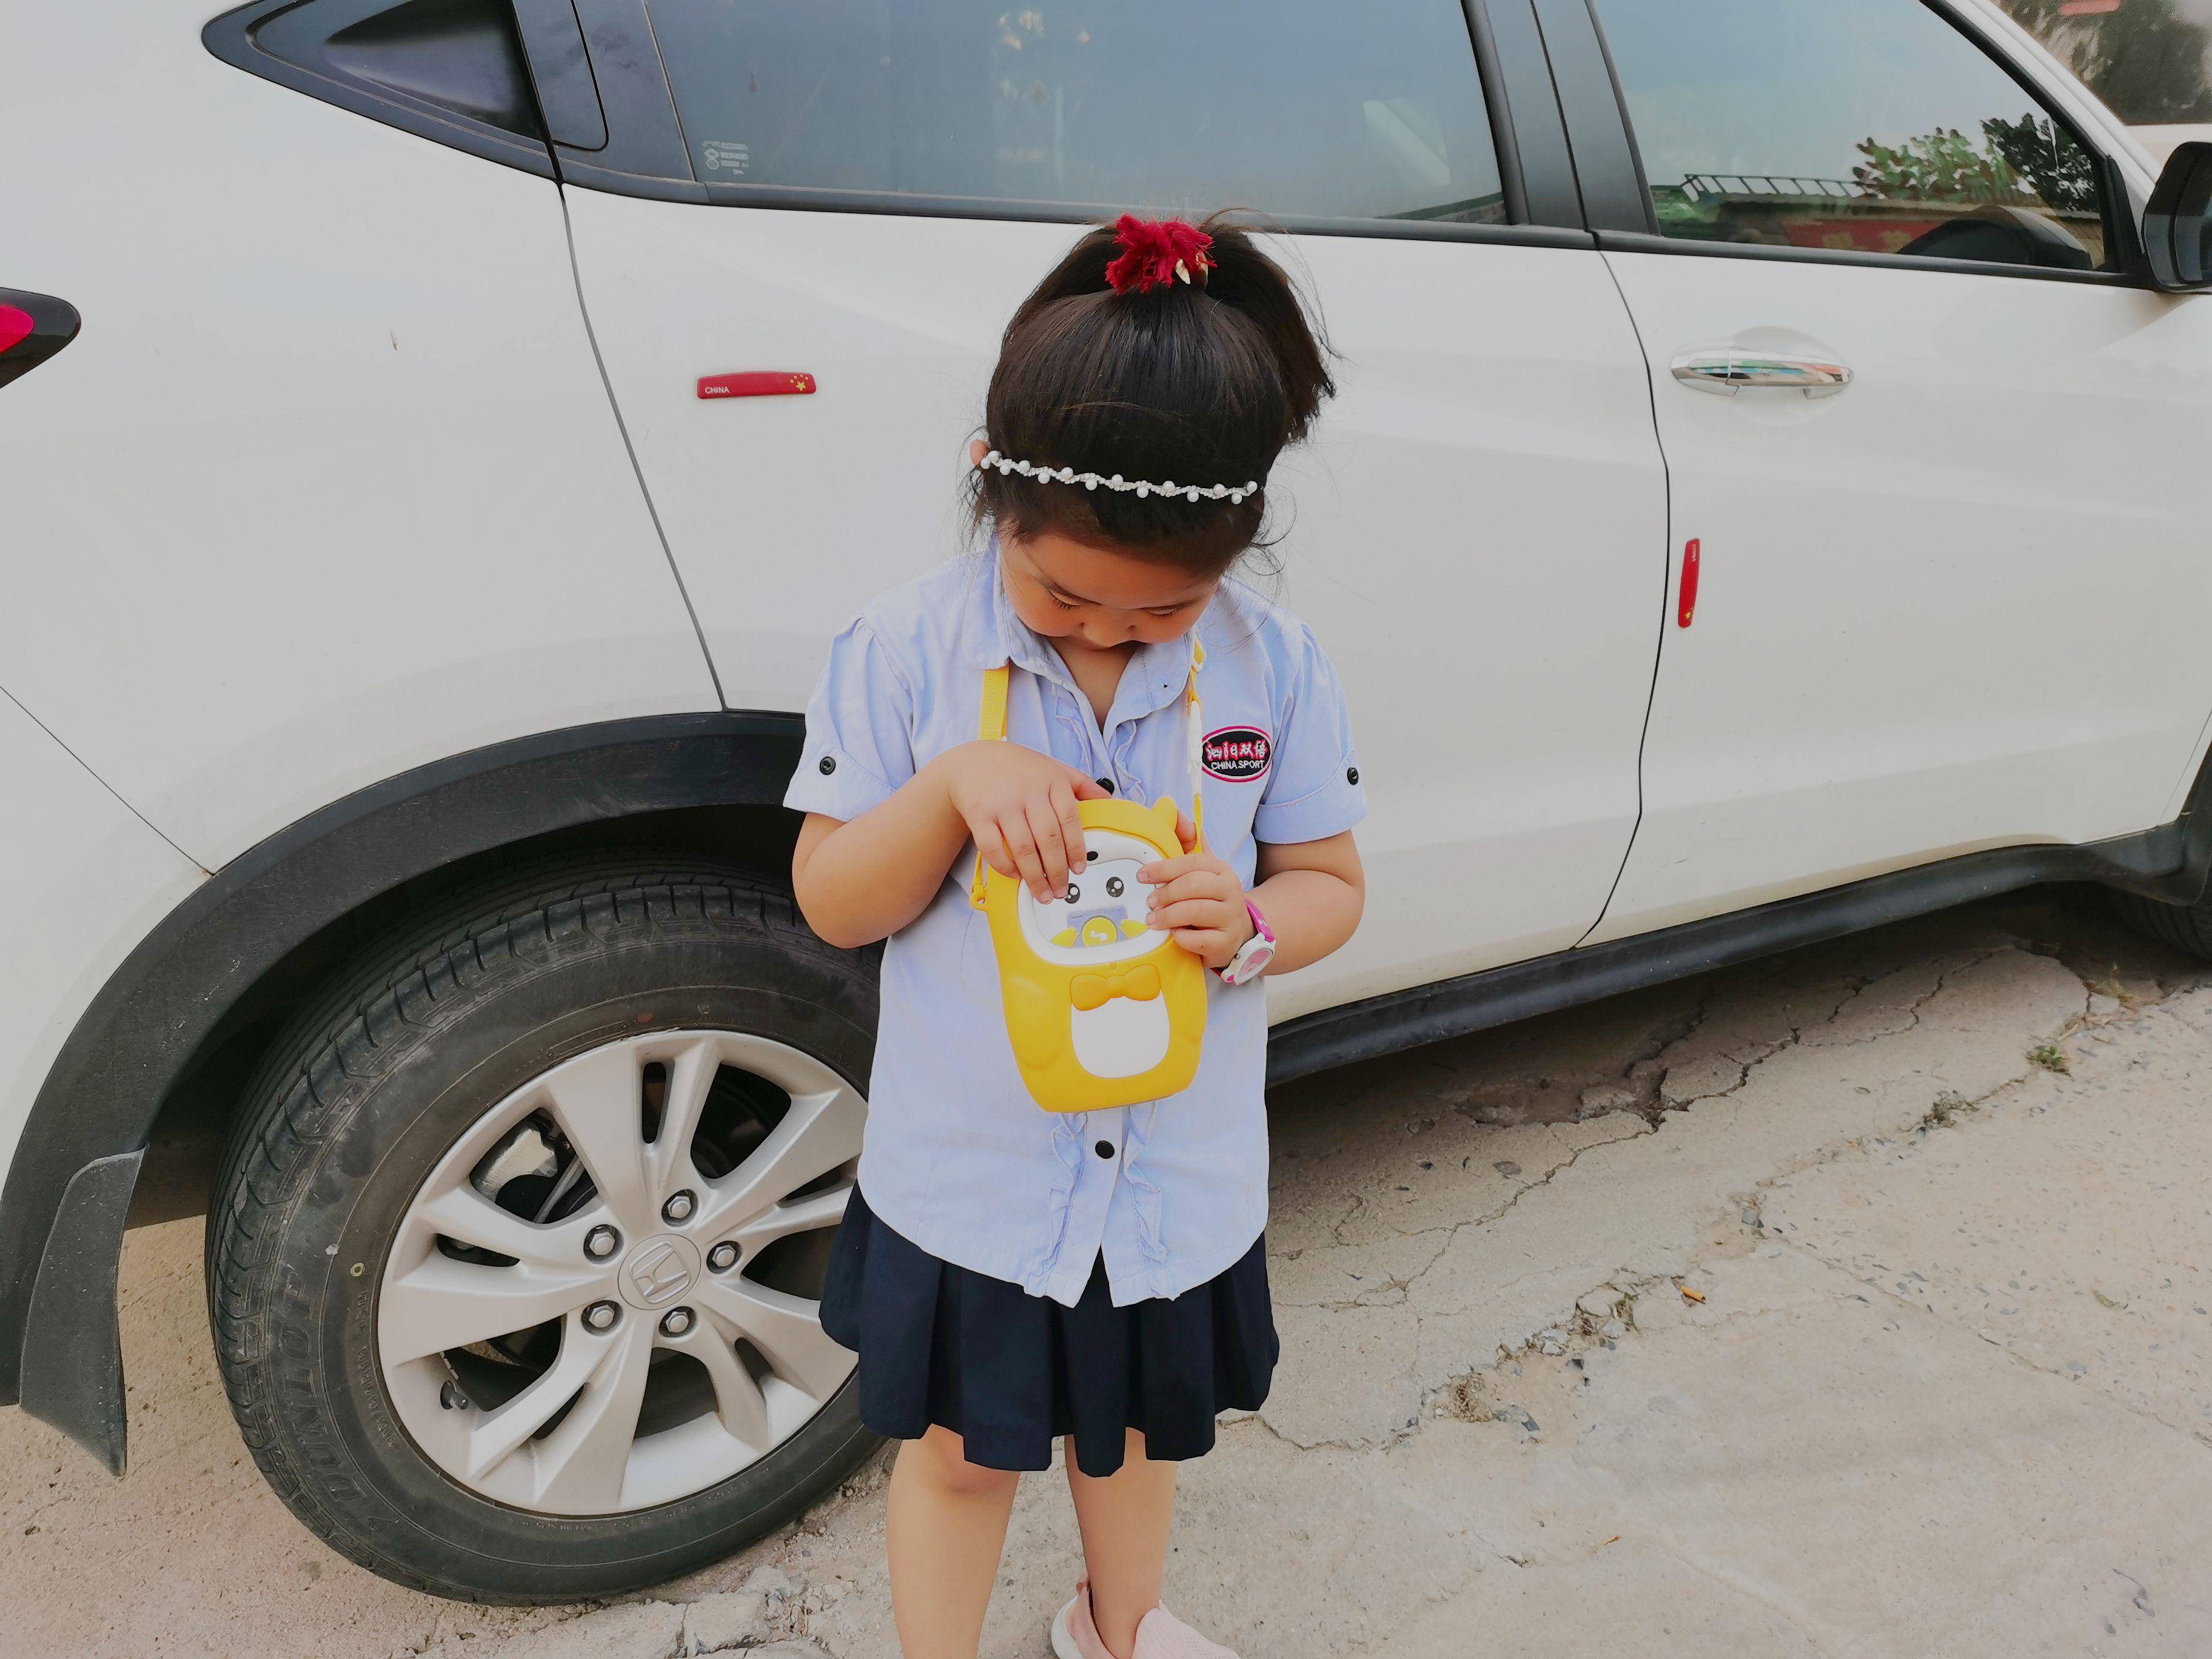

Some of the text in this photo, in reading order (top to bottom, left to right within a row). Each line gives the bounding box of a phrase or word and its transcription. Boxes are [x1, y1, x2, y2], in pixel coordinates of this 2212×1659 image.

[1211, 760, 1265, 770] CHINA SPORT
[278, 1272, 368, 1504] DUNLOP
